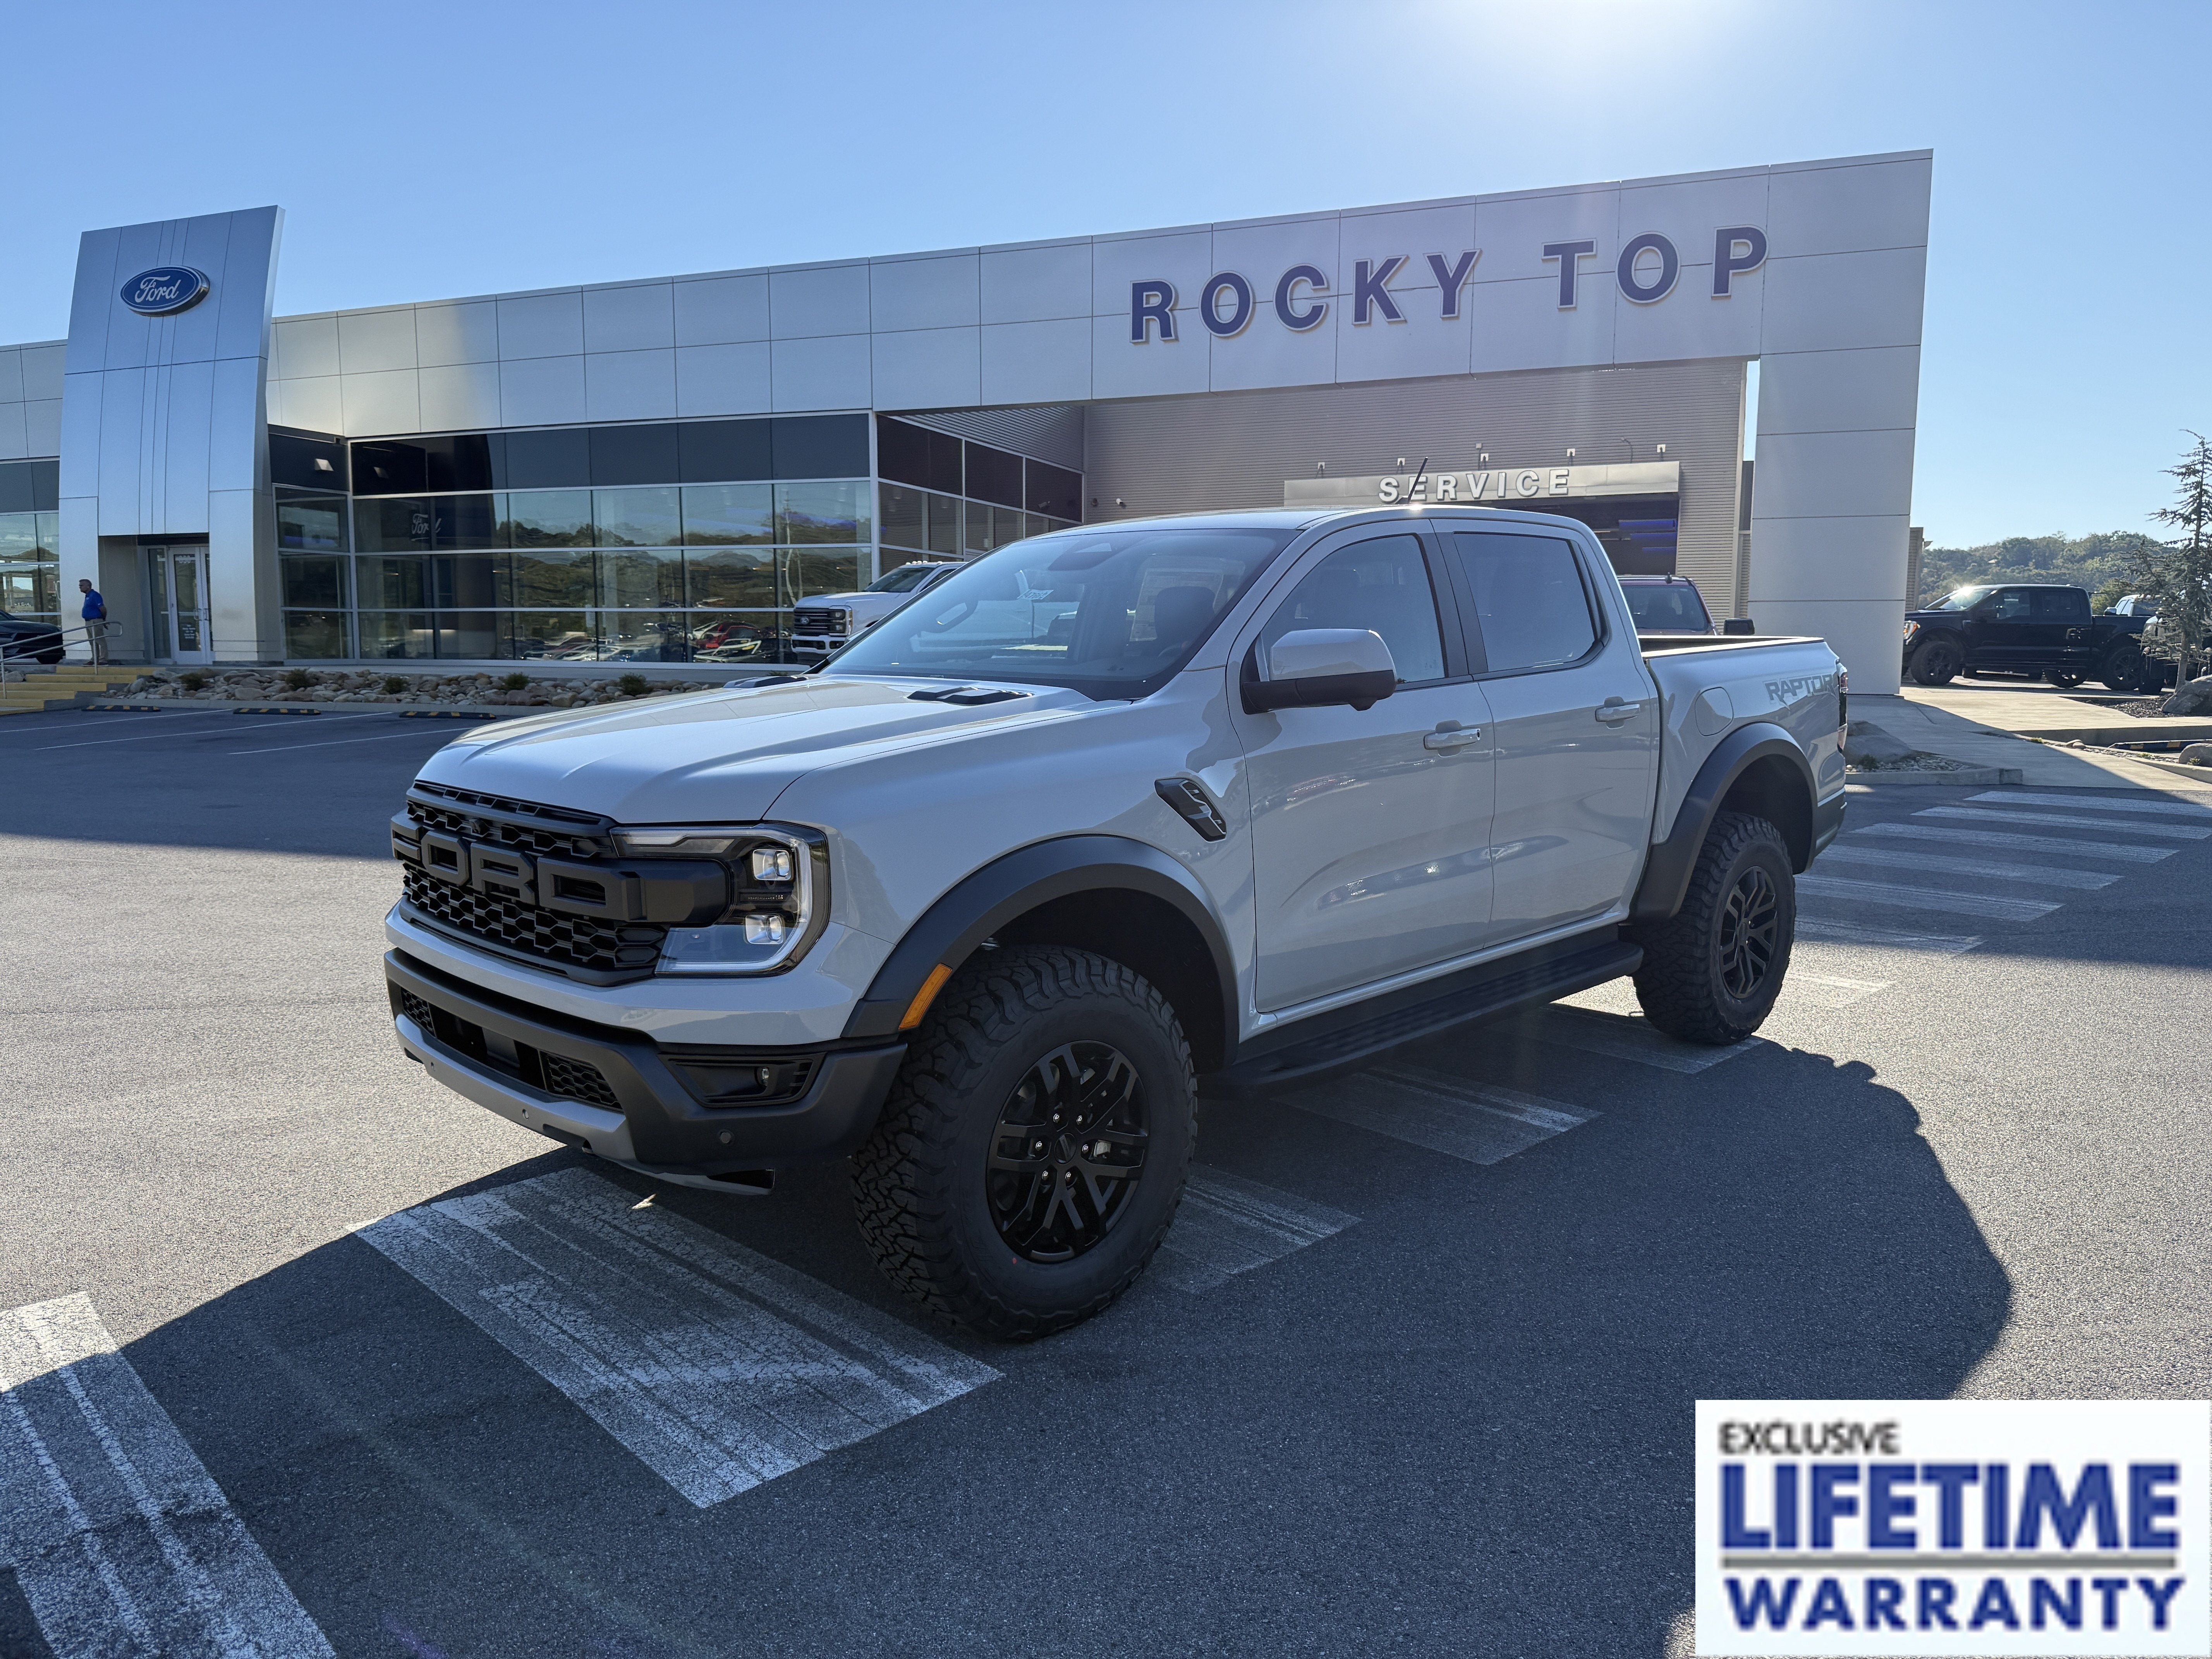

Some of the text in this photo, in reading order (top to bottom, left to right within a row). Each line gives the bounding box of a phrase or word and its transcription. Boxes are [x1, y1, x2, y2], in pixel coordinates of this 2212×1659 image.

[135, 275, 181, 302] Ford
[1130, 225, 1769, 343] ROCKY TOP
[1379, 469, 1569, 504] SERVICE
[1764, 674, 1839, 709] RAPTOR
[390, 815, 634, 922] FORD
